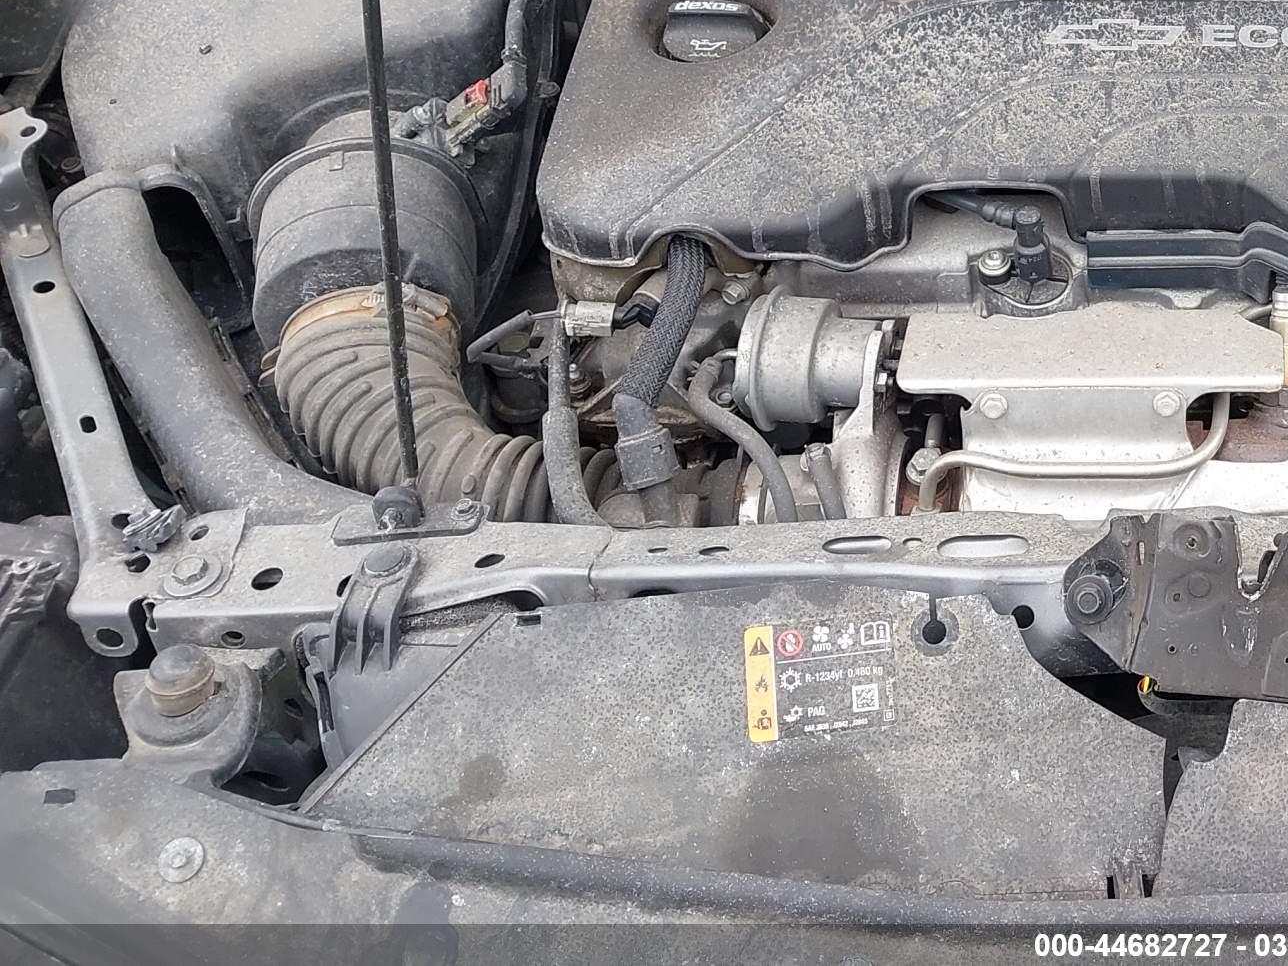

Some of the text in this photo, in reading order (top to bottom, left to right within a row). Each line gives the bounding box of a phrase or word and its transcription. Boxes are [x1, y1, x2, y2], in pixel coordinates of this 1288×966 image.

[674, 0, 739, 12] dexos
[812, 642, 832, 652] AUTO
[872, 665, 883, 676] kg
